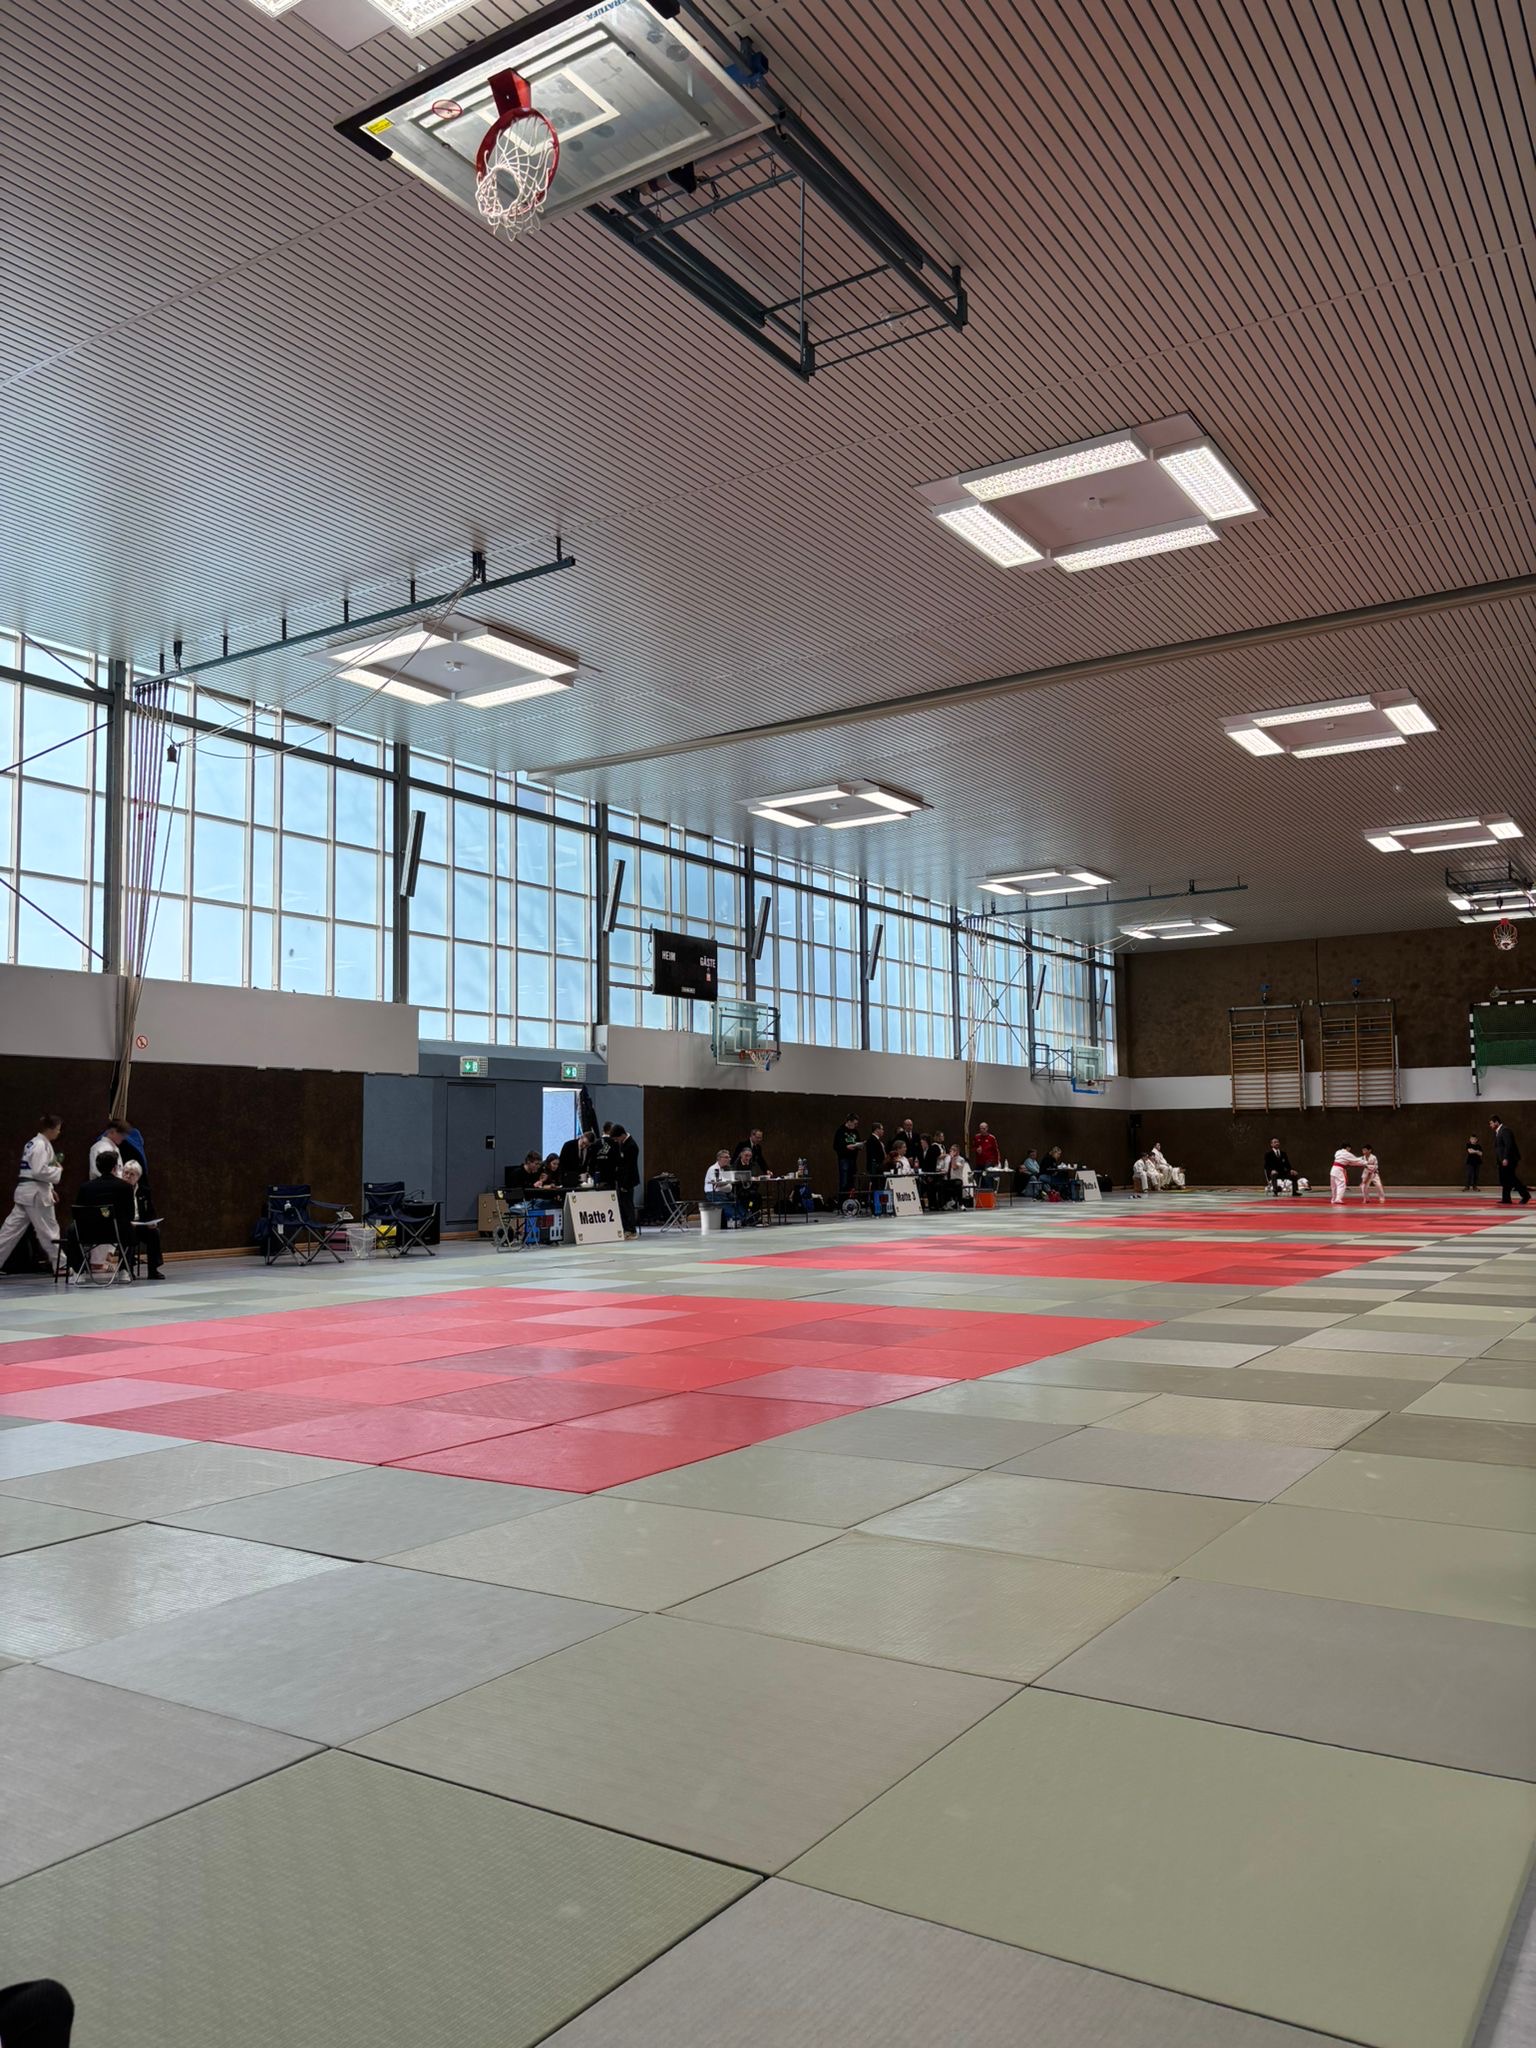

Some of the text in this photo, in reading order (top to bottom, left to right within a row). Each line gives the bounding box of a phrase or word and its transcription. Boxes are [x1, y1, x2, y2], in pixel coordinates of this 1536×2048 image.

[661, 950, 676, 961] HEIM
[700, 955, 716, 969] GÄSTE
[579, 1209, 615, 1224] Matte 2
